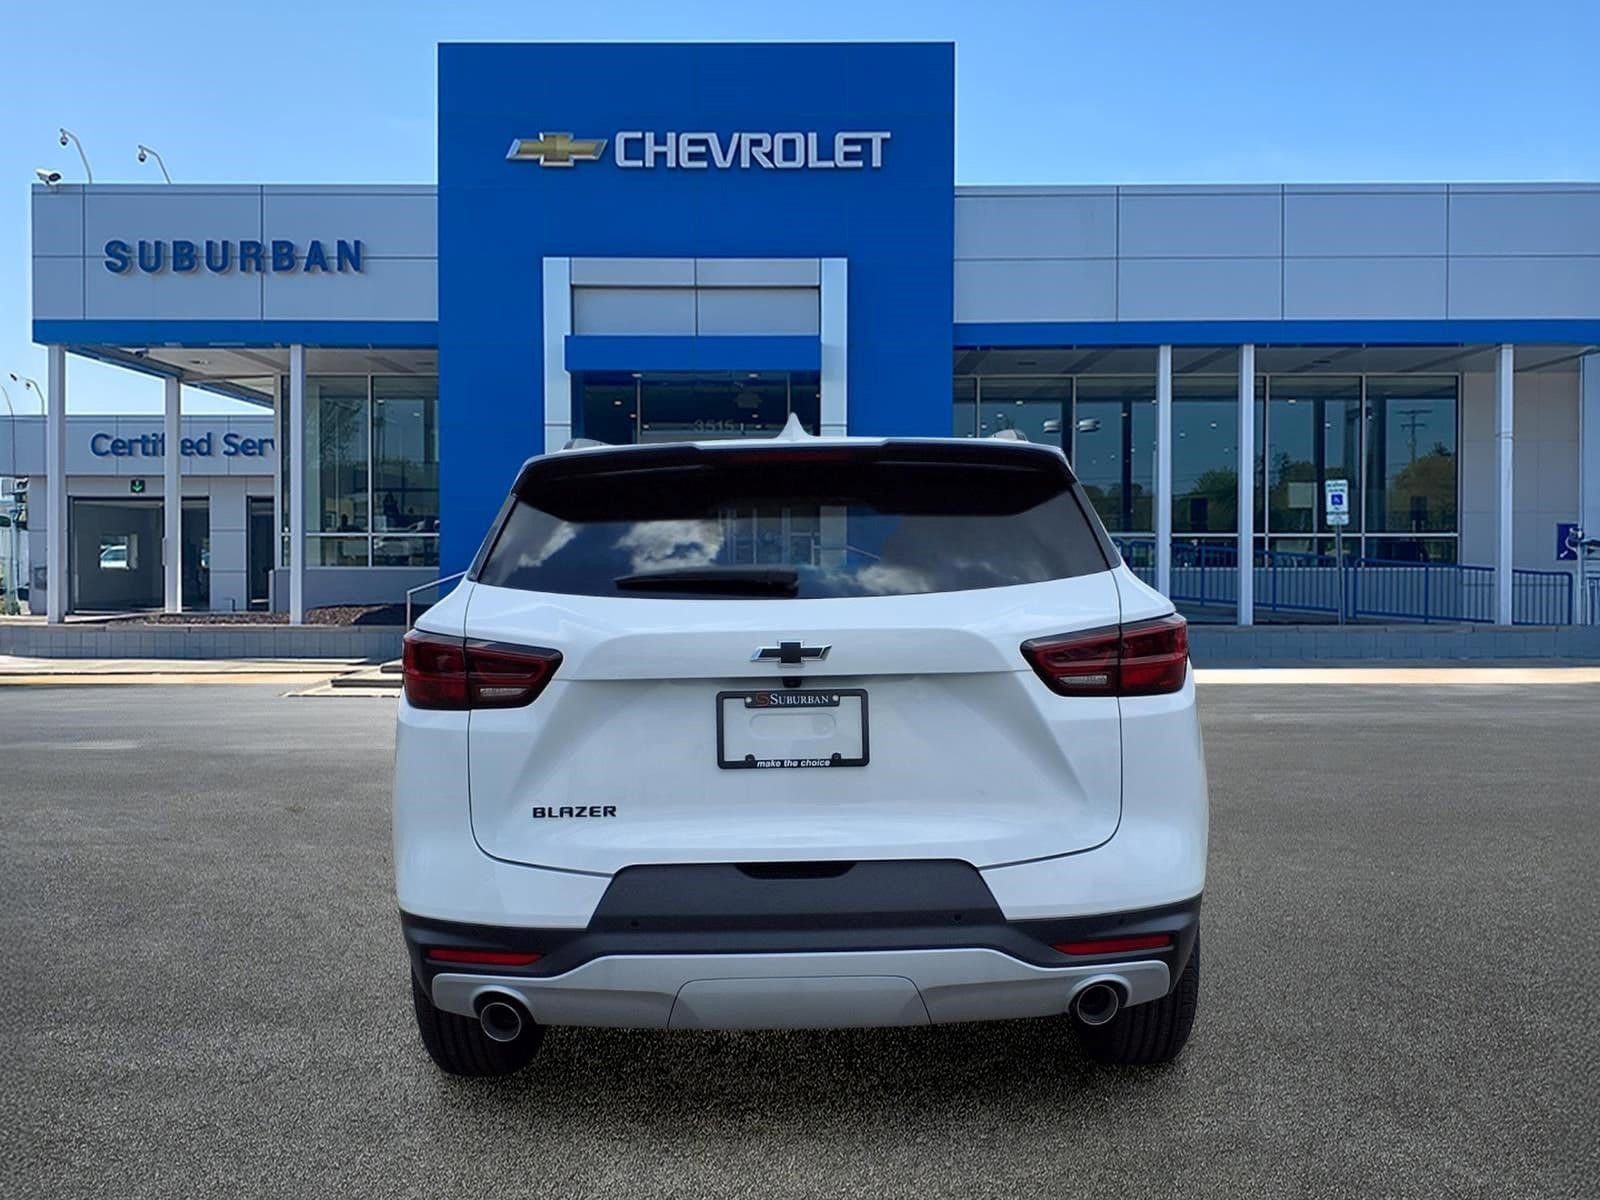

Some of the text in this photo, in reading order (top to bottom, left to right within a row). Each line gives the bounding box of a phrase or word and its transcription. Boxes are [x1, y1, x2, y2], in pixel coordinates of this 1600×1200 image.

[614, 131, 892, 169] CHEVROLET
[103, 239, 363, 274] SUBURBAN
[90, 432, 213, 457] Certifed
[756, 759, 831, 768] make the choice
[532, 805, 617, 819] BLAZER
